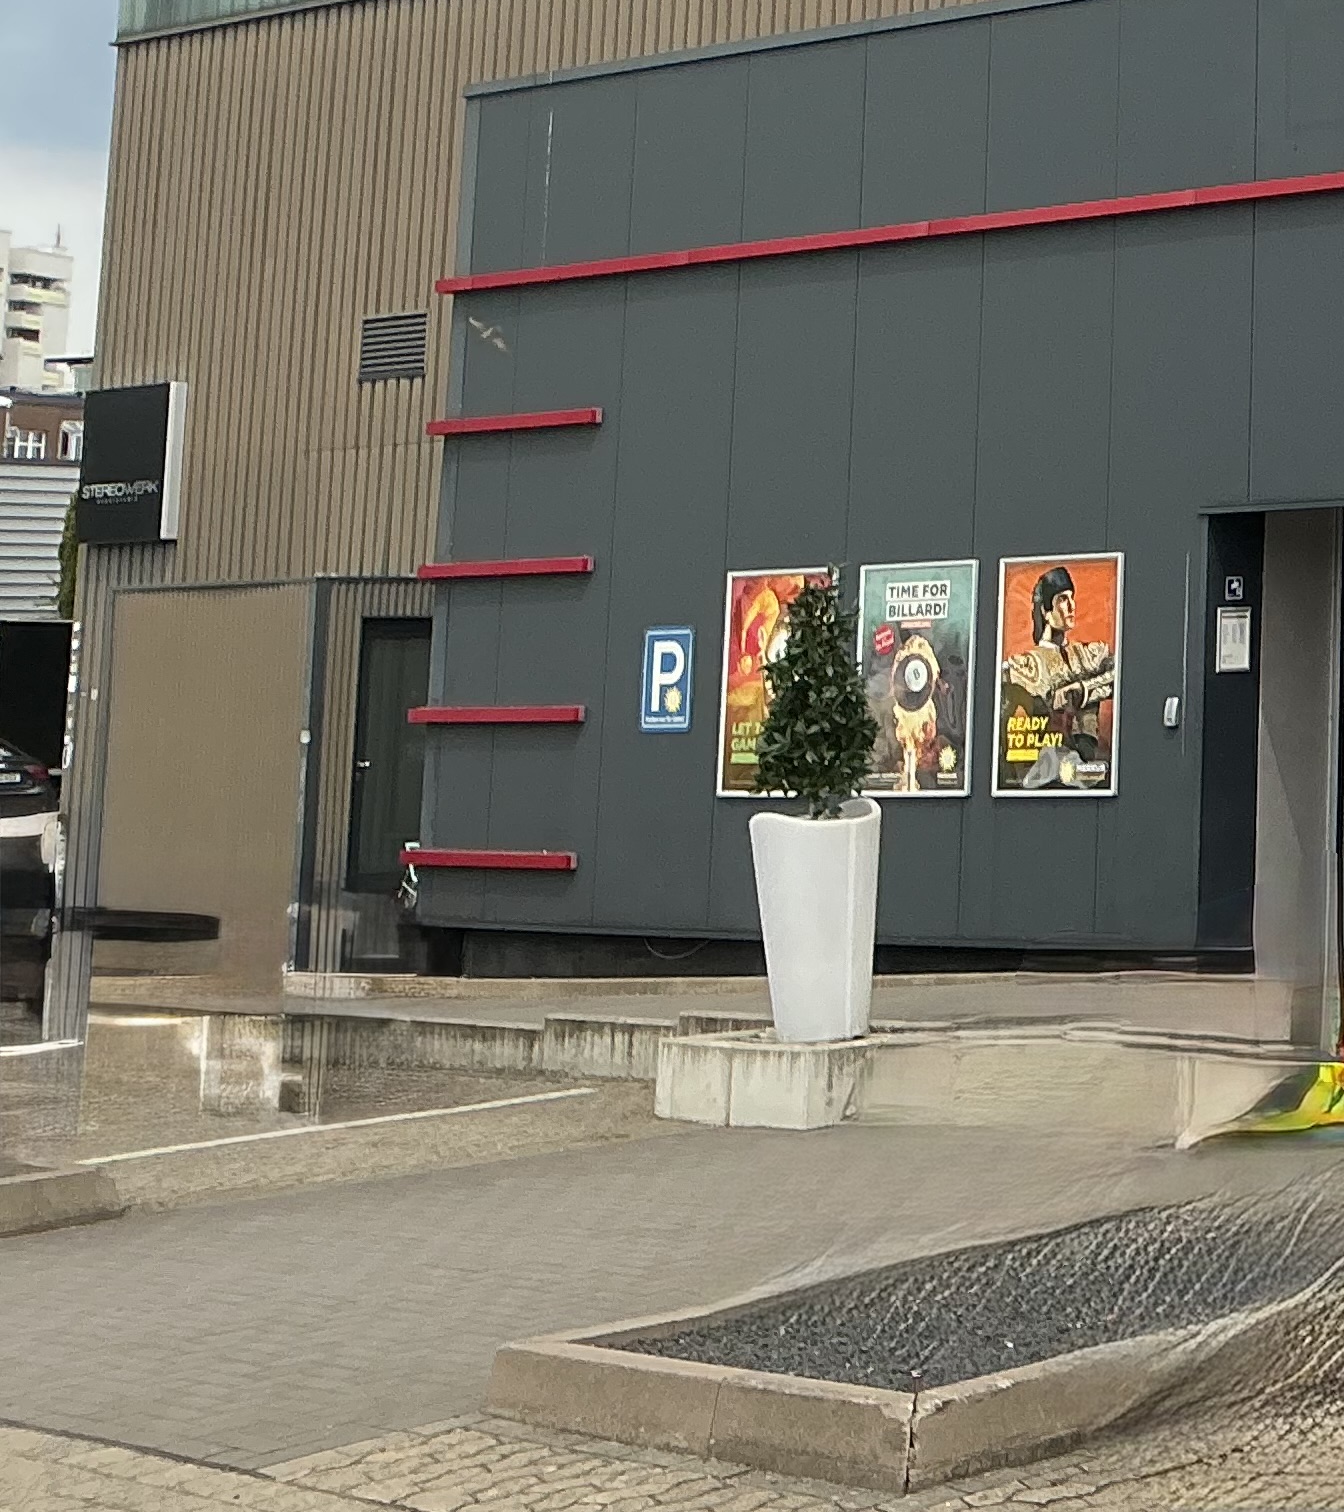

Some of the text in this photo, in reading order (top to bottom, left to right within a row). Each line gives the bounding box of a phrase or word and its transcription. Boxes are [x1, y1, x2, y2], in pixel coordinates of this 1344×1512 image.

[889, 583, 948, 598] TIME FOR
[888, 602, 946, 618] BILLARD!
[651, 640, 685, 712] P
[1007, 716, 1049, 731] READY
[731, 737, 757, 751] GAM
[1007, 732, 1063, 747] TO PLAY!
